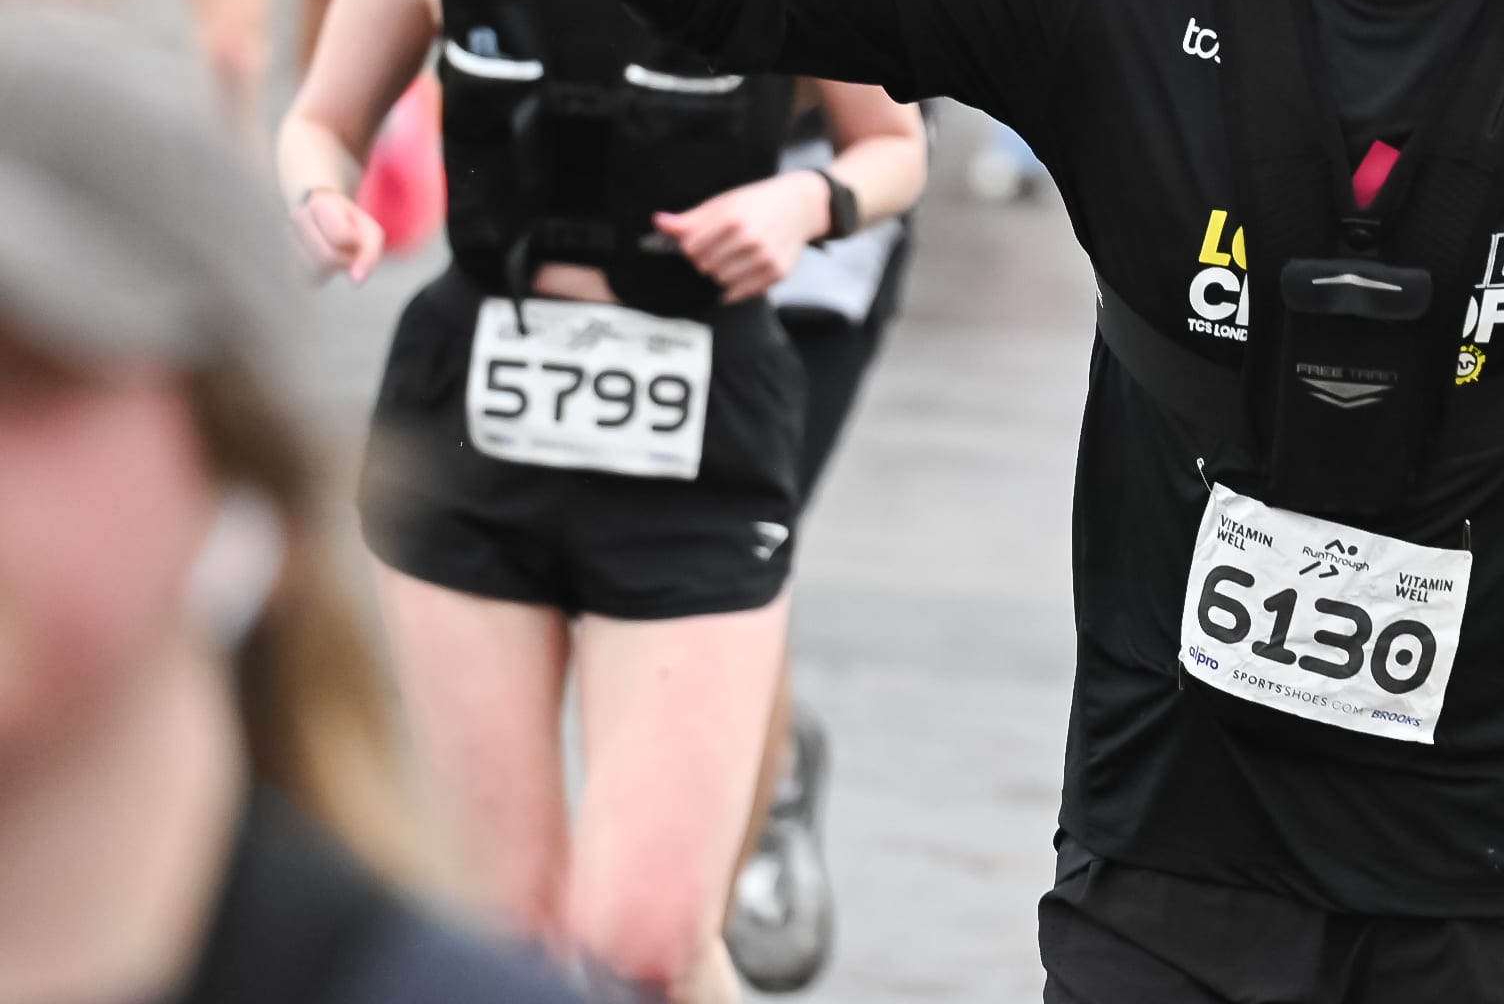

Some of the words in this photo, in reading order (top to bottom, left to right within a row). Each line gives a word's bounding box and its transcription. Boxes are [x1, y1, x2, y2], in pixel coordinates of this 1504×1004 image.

[1182, 17, 1221, 64] tc
[1187, 317, 1213, 335] TCS
[483, 358, 692, 433] 5799
[1217, 526, 1246, 551] WELL
[1220, 514, 1274, 548] VITAMIN
[1302, 546, 1370, 572] RunThrough
[1395, 584, 1428, 603] WELL
[1399, 572, 1453, 593] VITAMIN
[1197, 564, 1438, 695] 6130
[1188, 645, 1219, 671] alpro
[1371, 709, 1422, 728] BROOKS
